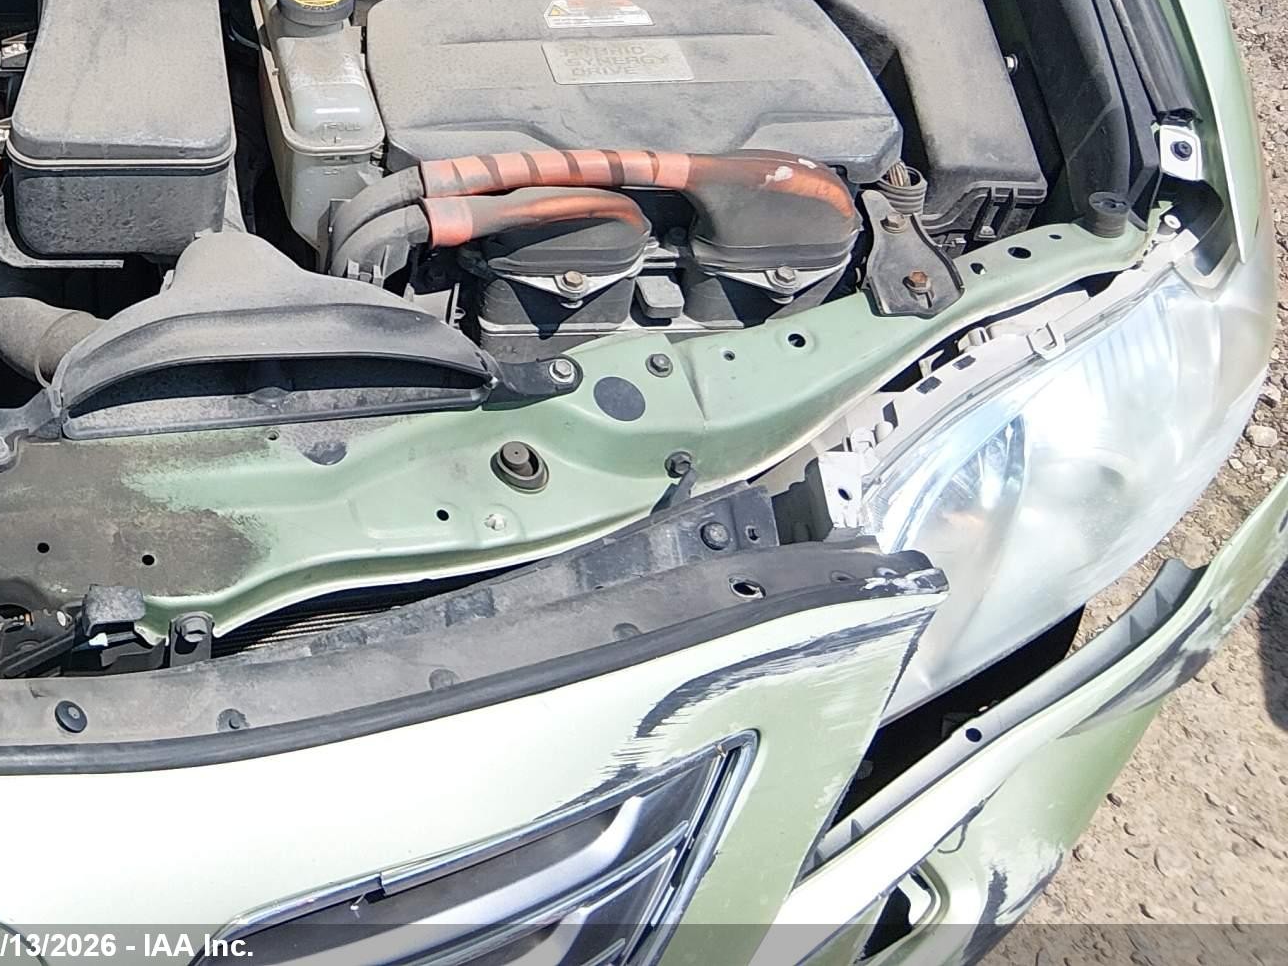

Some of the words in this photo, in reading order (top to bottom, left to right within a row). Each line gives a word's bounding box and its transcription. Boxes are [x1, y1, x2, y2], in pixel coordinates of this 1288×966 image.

[562, 44, 645, 57] HYBRID
[565, 53, 669, 67] SYNERGY
[572, 66, 638, 76] DRIVE
